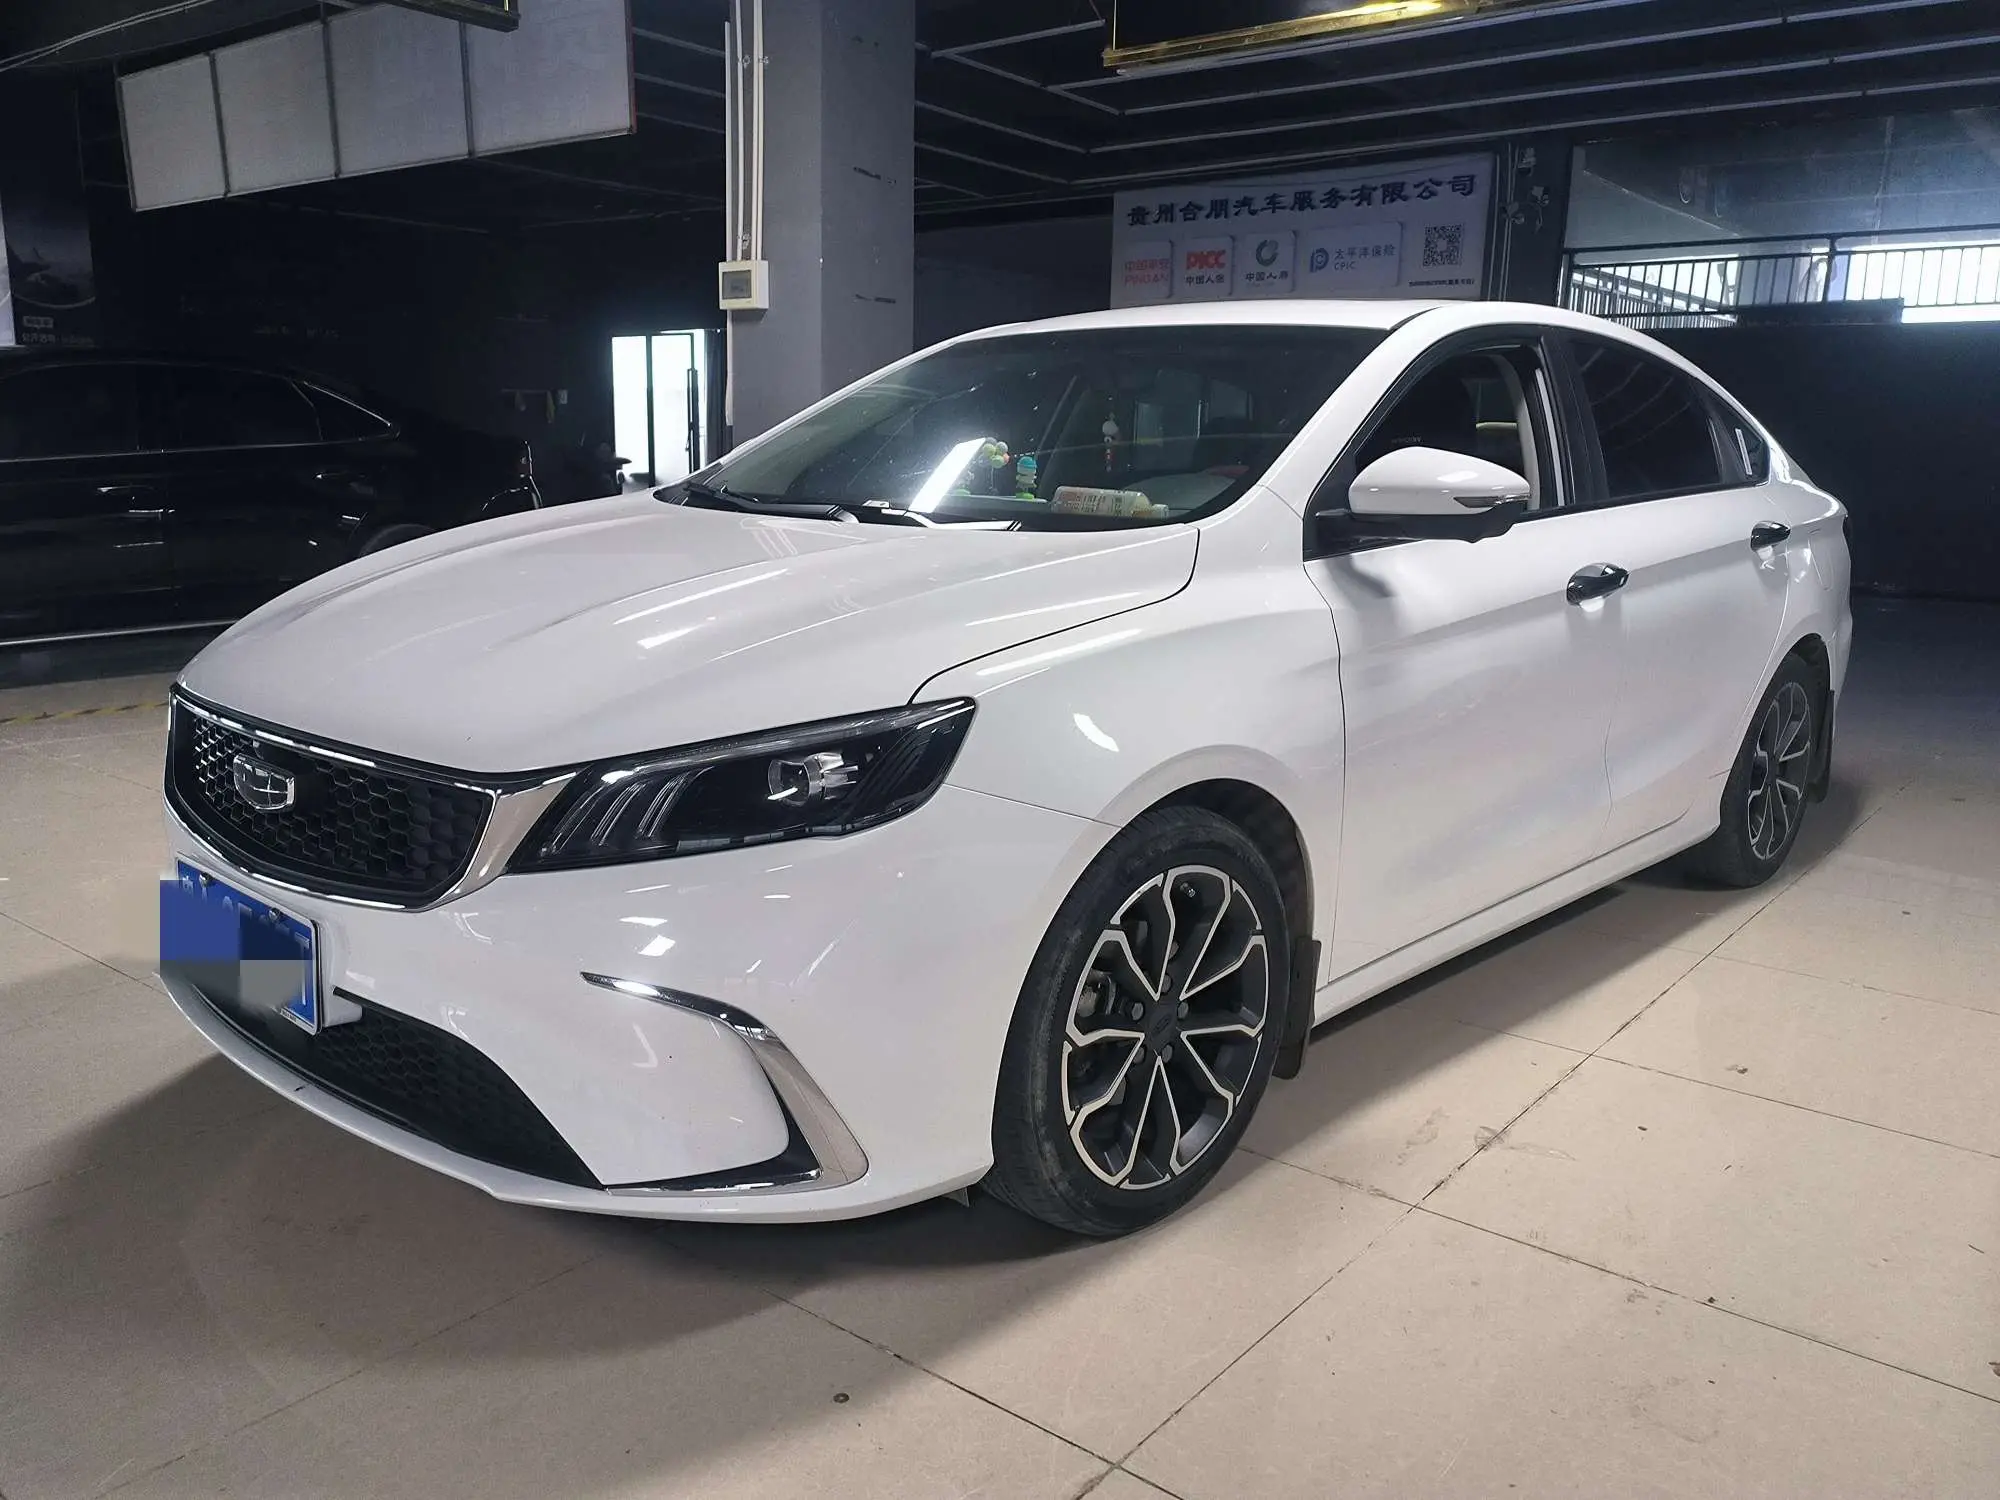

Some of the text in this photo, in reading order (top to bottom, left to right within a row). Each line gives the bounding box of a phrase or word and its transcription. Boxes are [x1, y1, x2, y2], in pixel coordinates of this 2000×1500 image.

[1127, 174, 1477, 226] 贵州合朋汽车服务有限公司
[1186, 250, 1226, 270] PICC
[1334, 244, 1397, 261] 太平洋保险
[1334, 261, 1358, 271] CPIC
